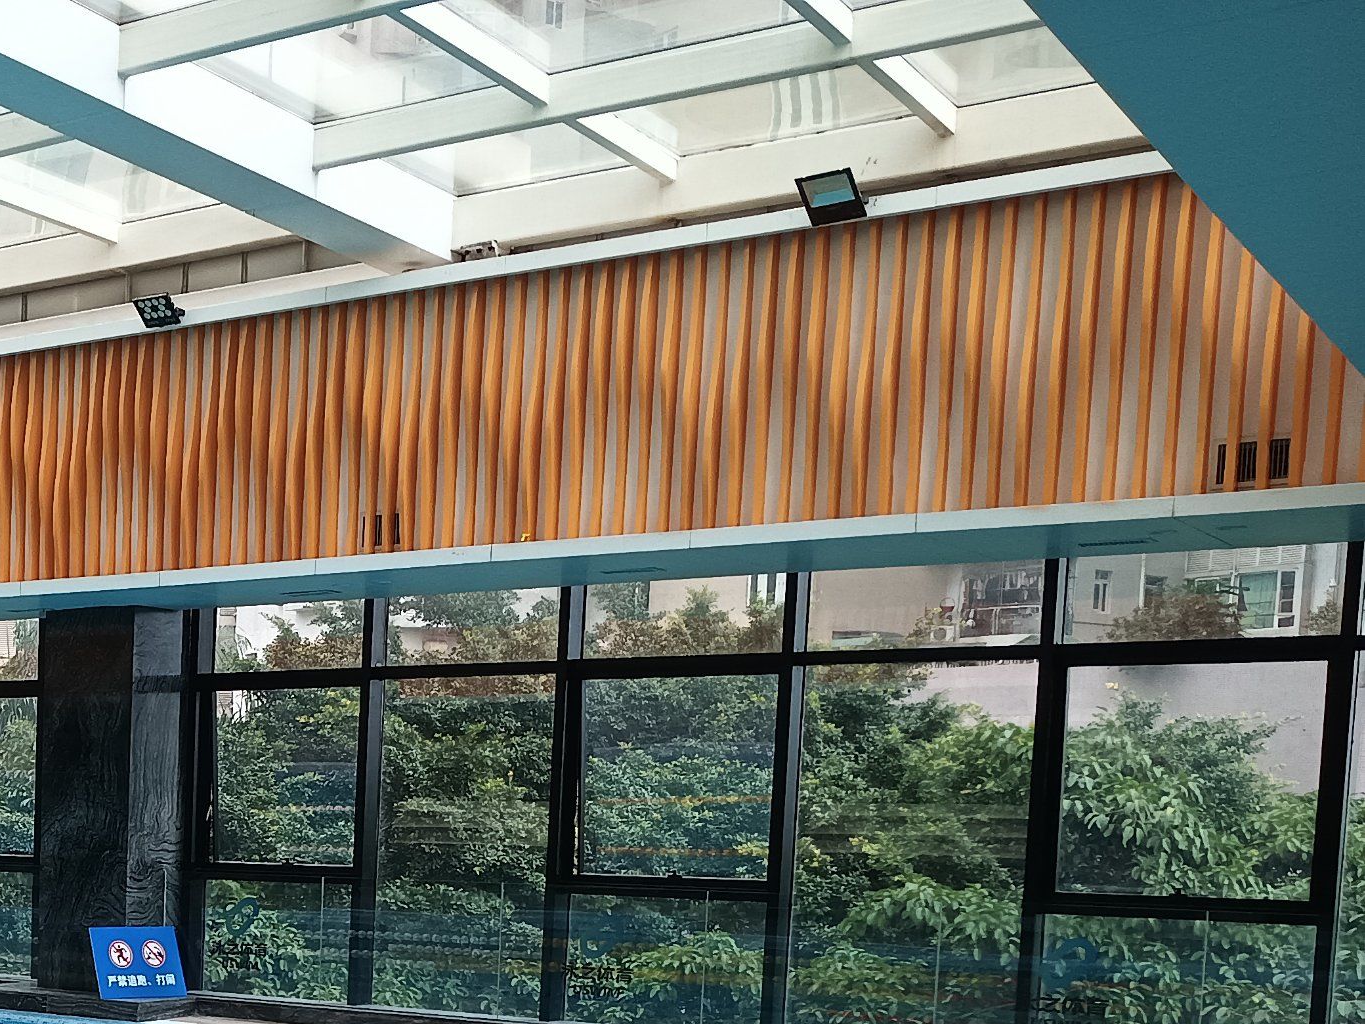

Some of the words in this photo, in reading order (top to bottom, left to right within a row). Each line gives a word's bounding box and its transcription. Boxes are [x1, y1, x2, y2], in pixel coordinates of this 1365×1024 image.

[107, 973, 176, 987] 严禁追跑、打闹
